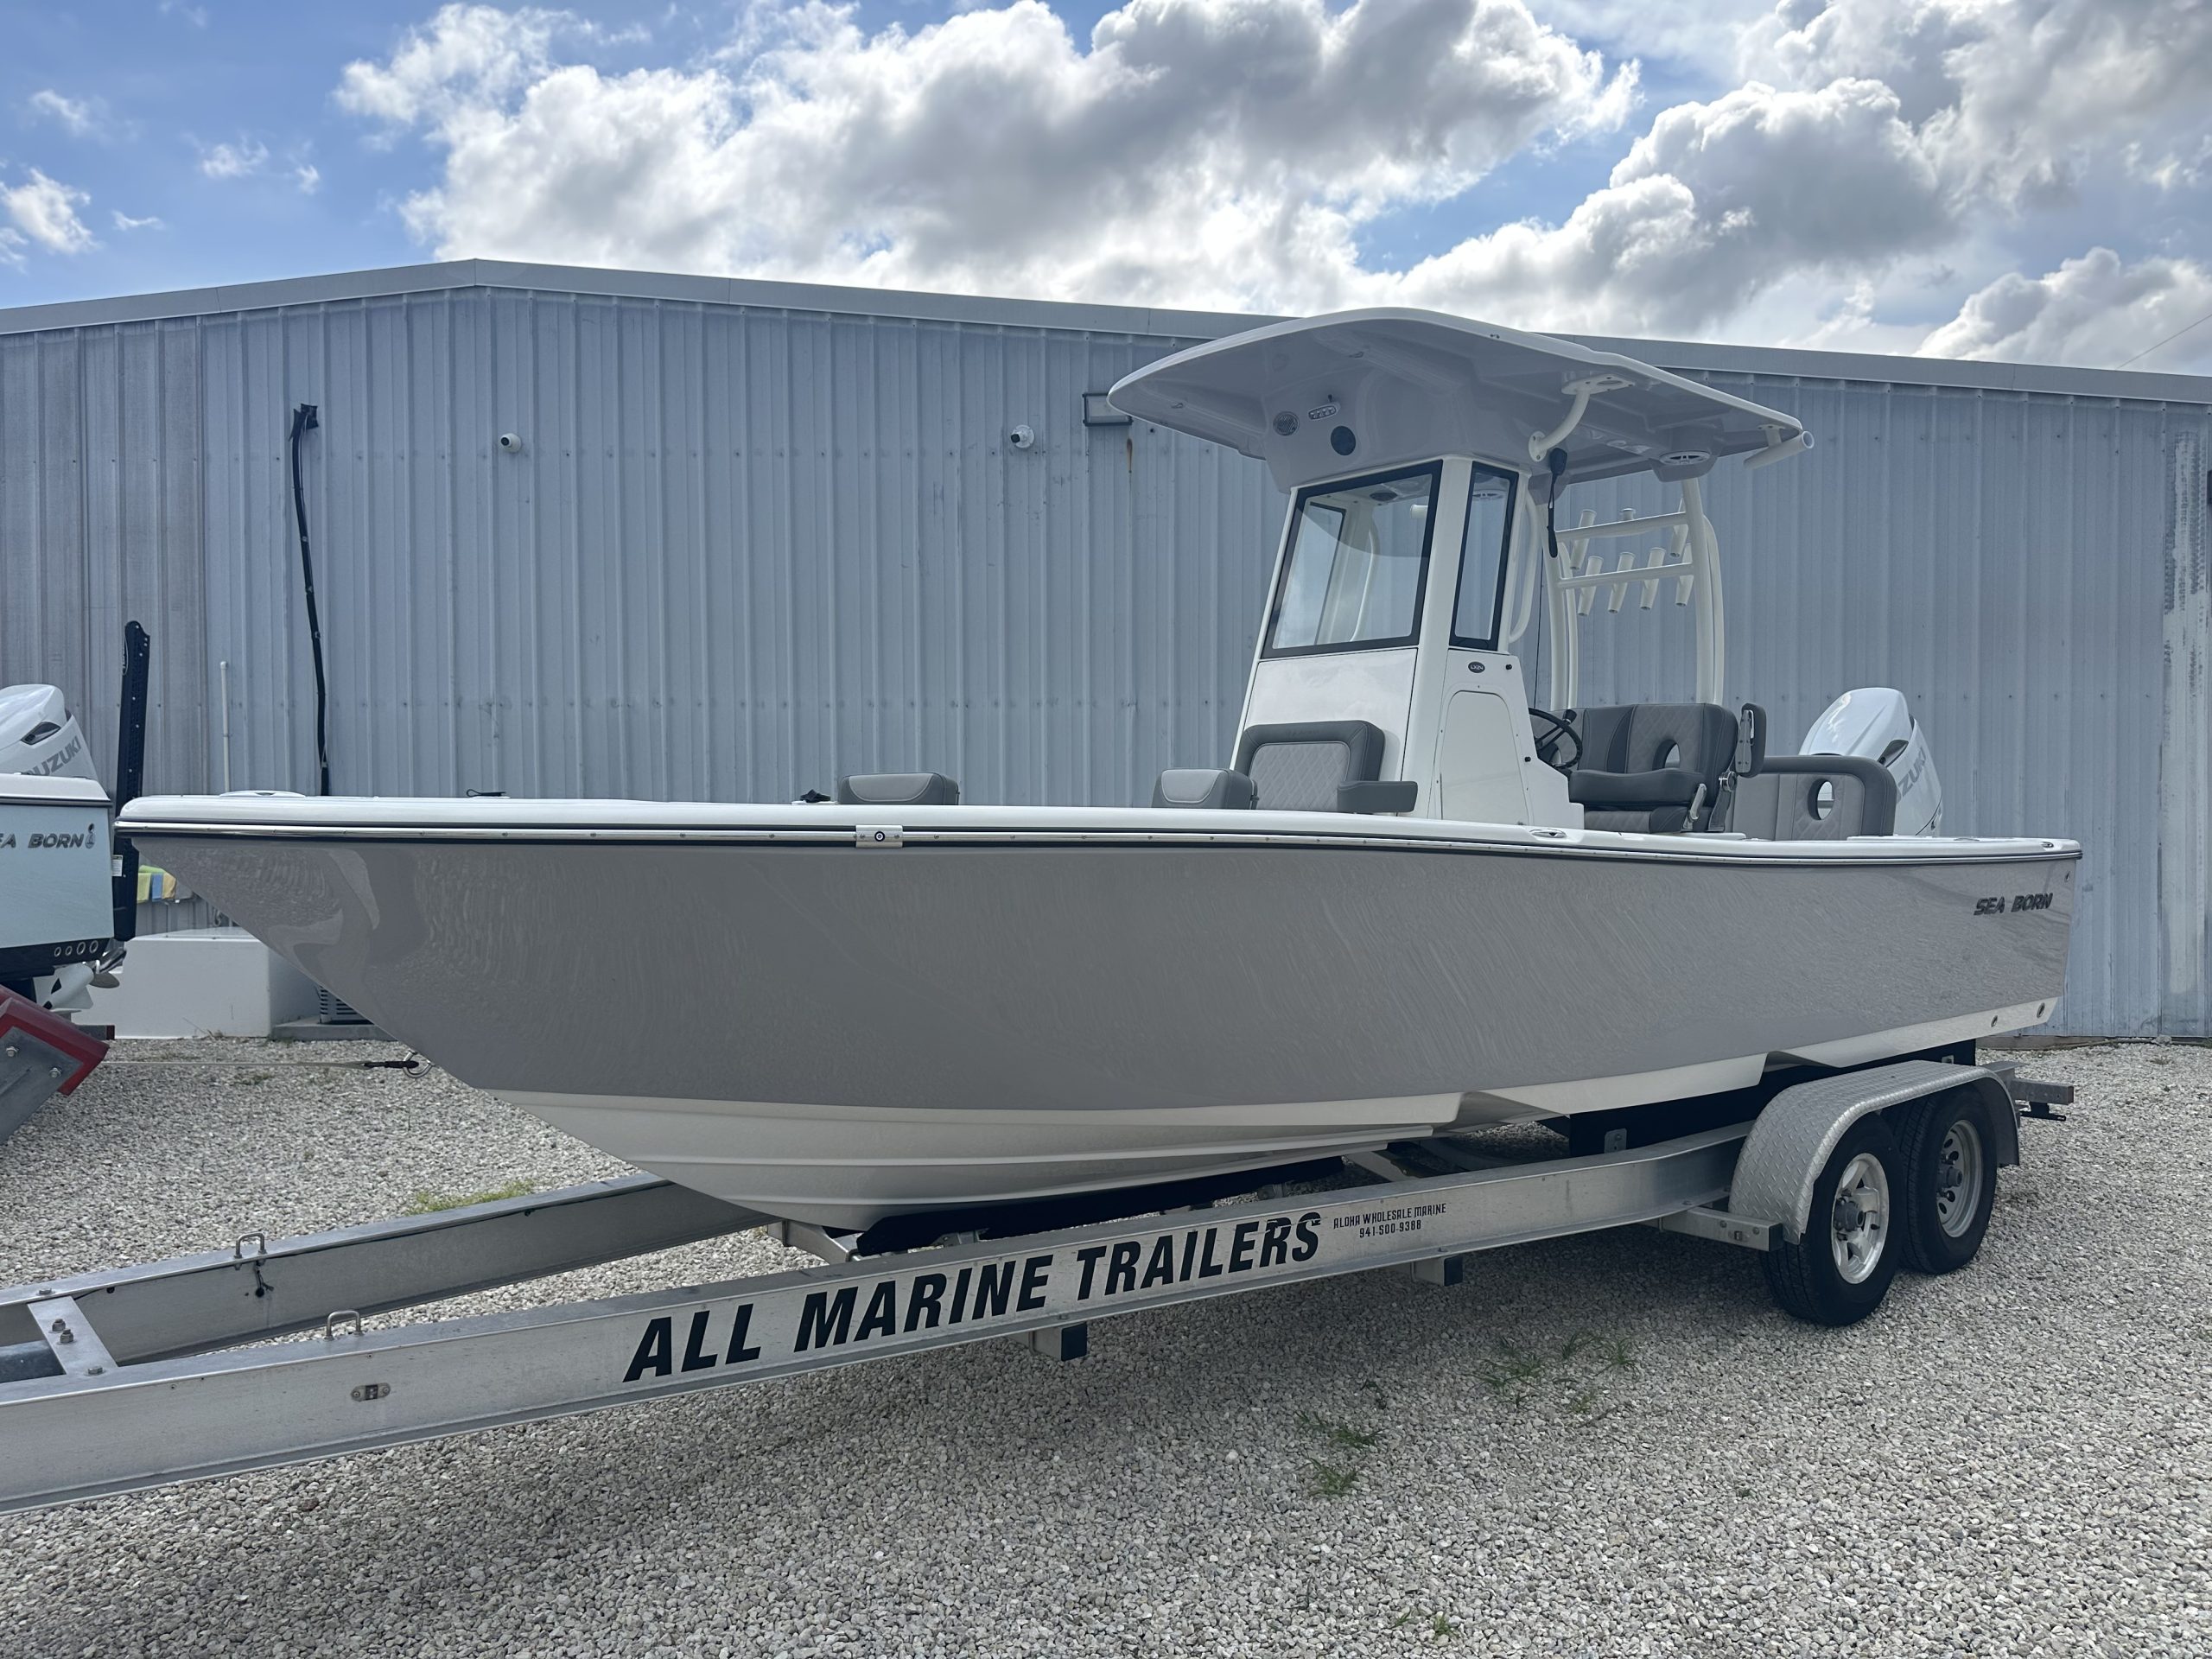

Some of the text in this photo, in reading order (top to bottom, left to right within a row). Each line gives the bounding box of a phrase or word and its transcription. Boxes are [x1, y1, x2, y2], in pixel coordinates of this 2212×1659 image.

[28, 833, 85, 849] BORN
[1974, 893, 2053, 915] SEA BORN
[1333, 1203, 1446, 1230] ALOHA WHOLESALE MARINE
[1359, 1219, 1421, 1238] 941-500-9388
[622, 1211, 1321, 1382] ALL MARINE TRAILERS
